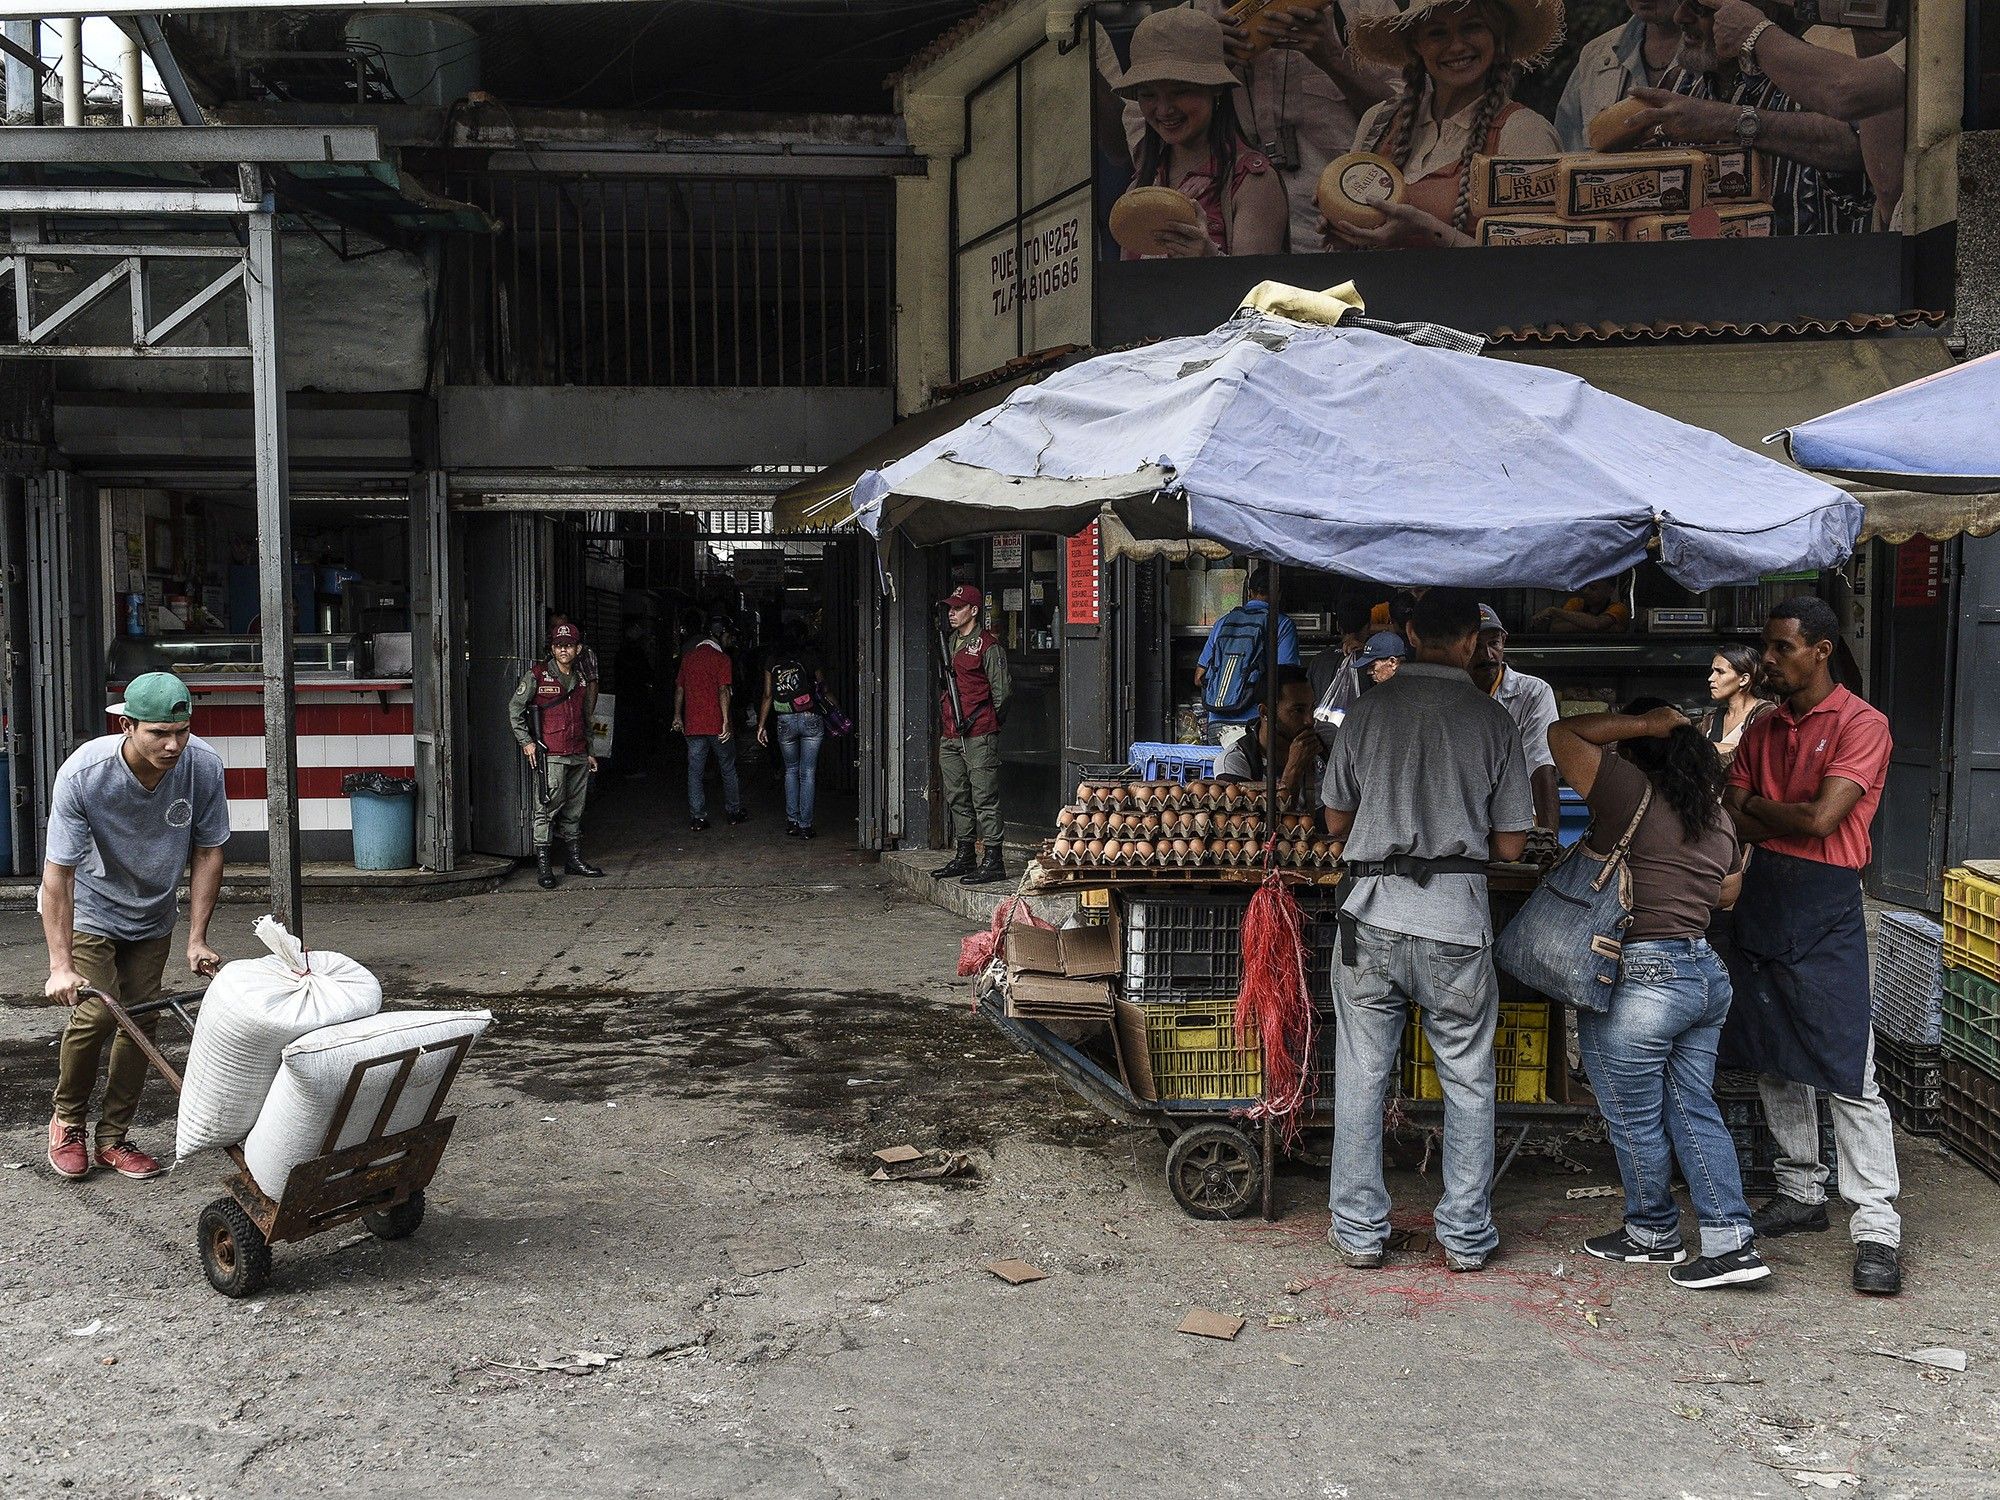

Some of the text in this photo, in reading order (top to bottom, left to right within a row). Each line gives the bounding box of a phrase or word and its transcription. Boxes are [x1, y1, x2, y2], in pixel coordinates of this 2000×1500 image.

[1513, 176, 1532, 186] LOS
[1593, 185, 1612, 195] LOS
[1593, 180, 1655, 208] FRAILES
[1003, 538, 1021, 546] MORA
